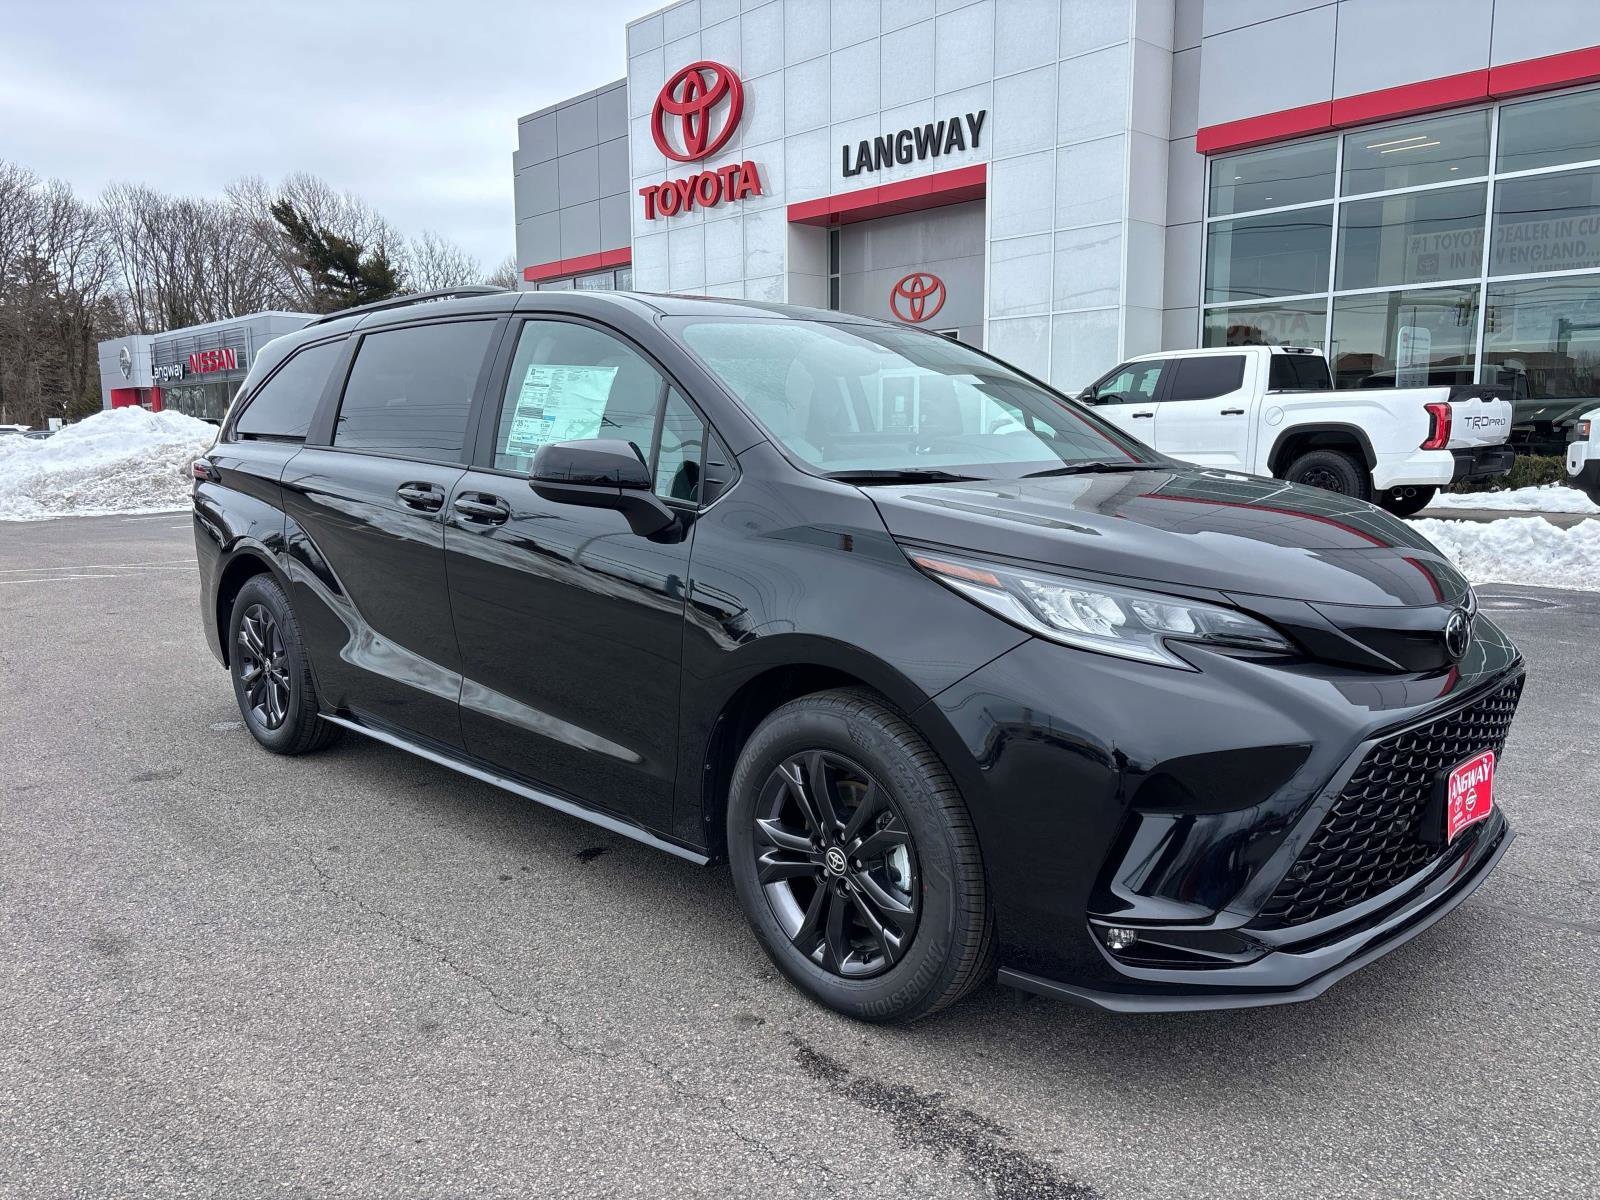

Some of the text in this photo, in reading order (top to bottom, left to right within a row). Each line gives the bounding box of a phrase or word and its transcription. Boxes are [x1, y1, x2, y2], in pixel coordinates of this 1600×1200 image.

[842, 110, 986, 178] LANGWAY
[639, 161, 763, 221] TOYOTA
[1555, 219, 1573, 238] IN
[1450, 251, 1467, 269] IN
[151, 347, 239, 381] Langway NISSAN
[1464, 416, 1489, 430] TRD
